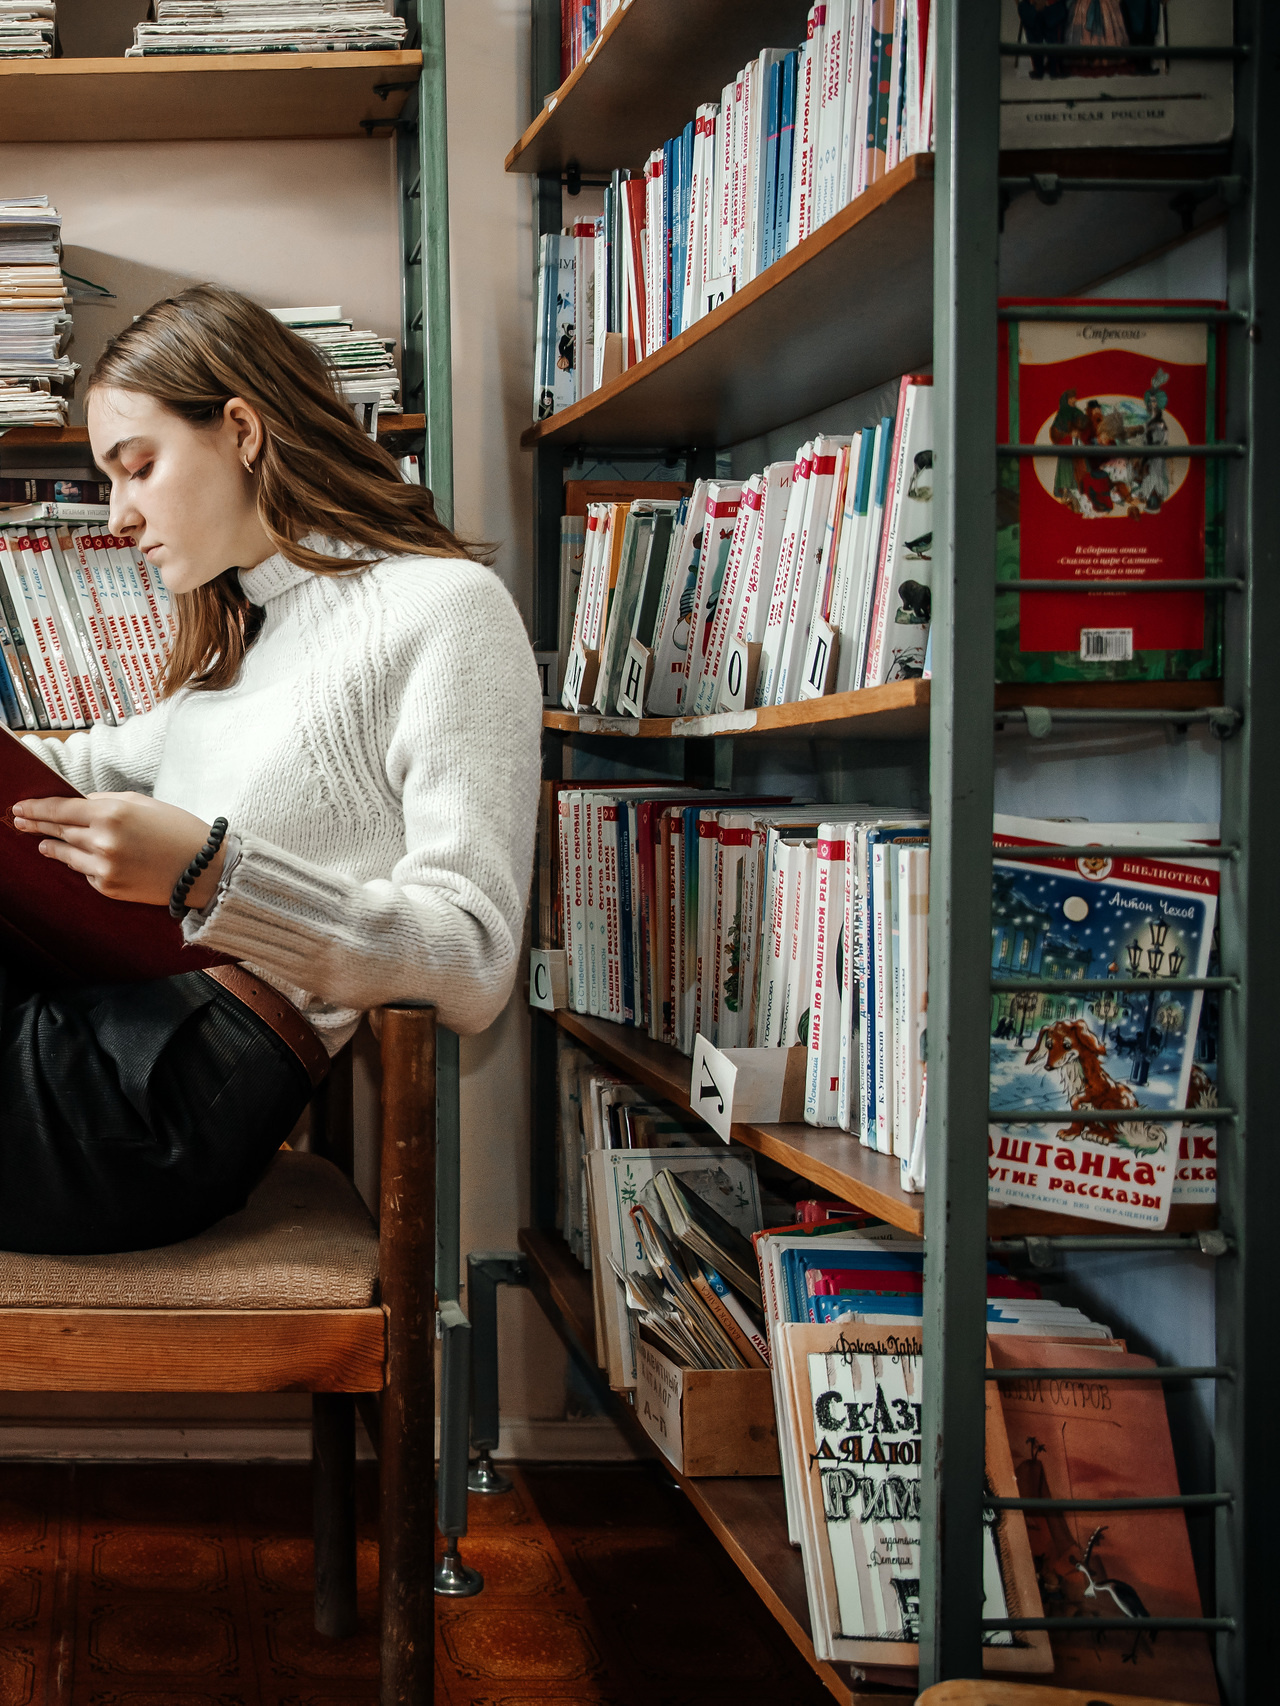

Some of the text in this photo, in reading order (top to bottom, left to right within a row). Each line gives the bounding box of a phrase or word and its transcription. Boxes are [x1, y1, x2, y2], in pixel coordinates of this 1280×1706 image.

[828, 34, 836, 101] МАУГЛИ
[803, 57, 812, 144] КУРОЛЕСОВА
[1026, 109, 1166, 123] СОВЕТСКАЯ РОССИЯ
[752, 476, 767, 592] ОСТРОВ НЕЗНАЙКИ
[116, 566, 126, 589] класс
[137, 560, 150, 591] ЧУДЕС
[782, 532, 795, 594] ТОЛСТЯКА
[795, 530, 807, 593] ТОЛСТЯКА
[688, 612, 699, 652] МАЛЕЕВ
[703, 523, 711, 553] ДОМА
[130, 614, 144, 649] ЧТЕНИЕ
[147, 593, 164, 630] СТРАНЕ
[872, 631, 883, 680] РАССКАЗЫ
[880, 576, 890, 619] ПРИРОДЕ
[623, 656, 642, 705] Н
[728, 650, 742, 696] О
[38, 674, 57, 720] БЫЛИНЫ
[574, 865, 582, 907] ОСТРОВ
[1122, 862, 1211, 888] БИБЛИОТЕКА
[1108, 891, 1195, 919] Антон Чехов
[535, 963, 547, 1000] С
[713, 936, 721, 1022] ПРИКЛЮЧЕНИЯ
[812, 867, 828, 1051] ВНИЗ ПО ВОЛШЕБНОЙ РЕКЕ
[699, 1055, 724, 1115] У
[988, 1166, 1038, 1187] УГИЕ
[1050, 1379, 1111, 1410] ОСТРОВ
